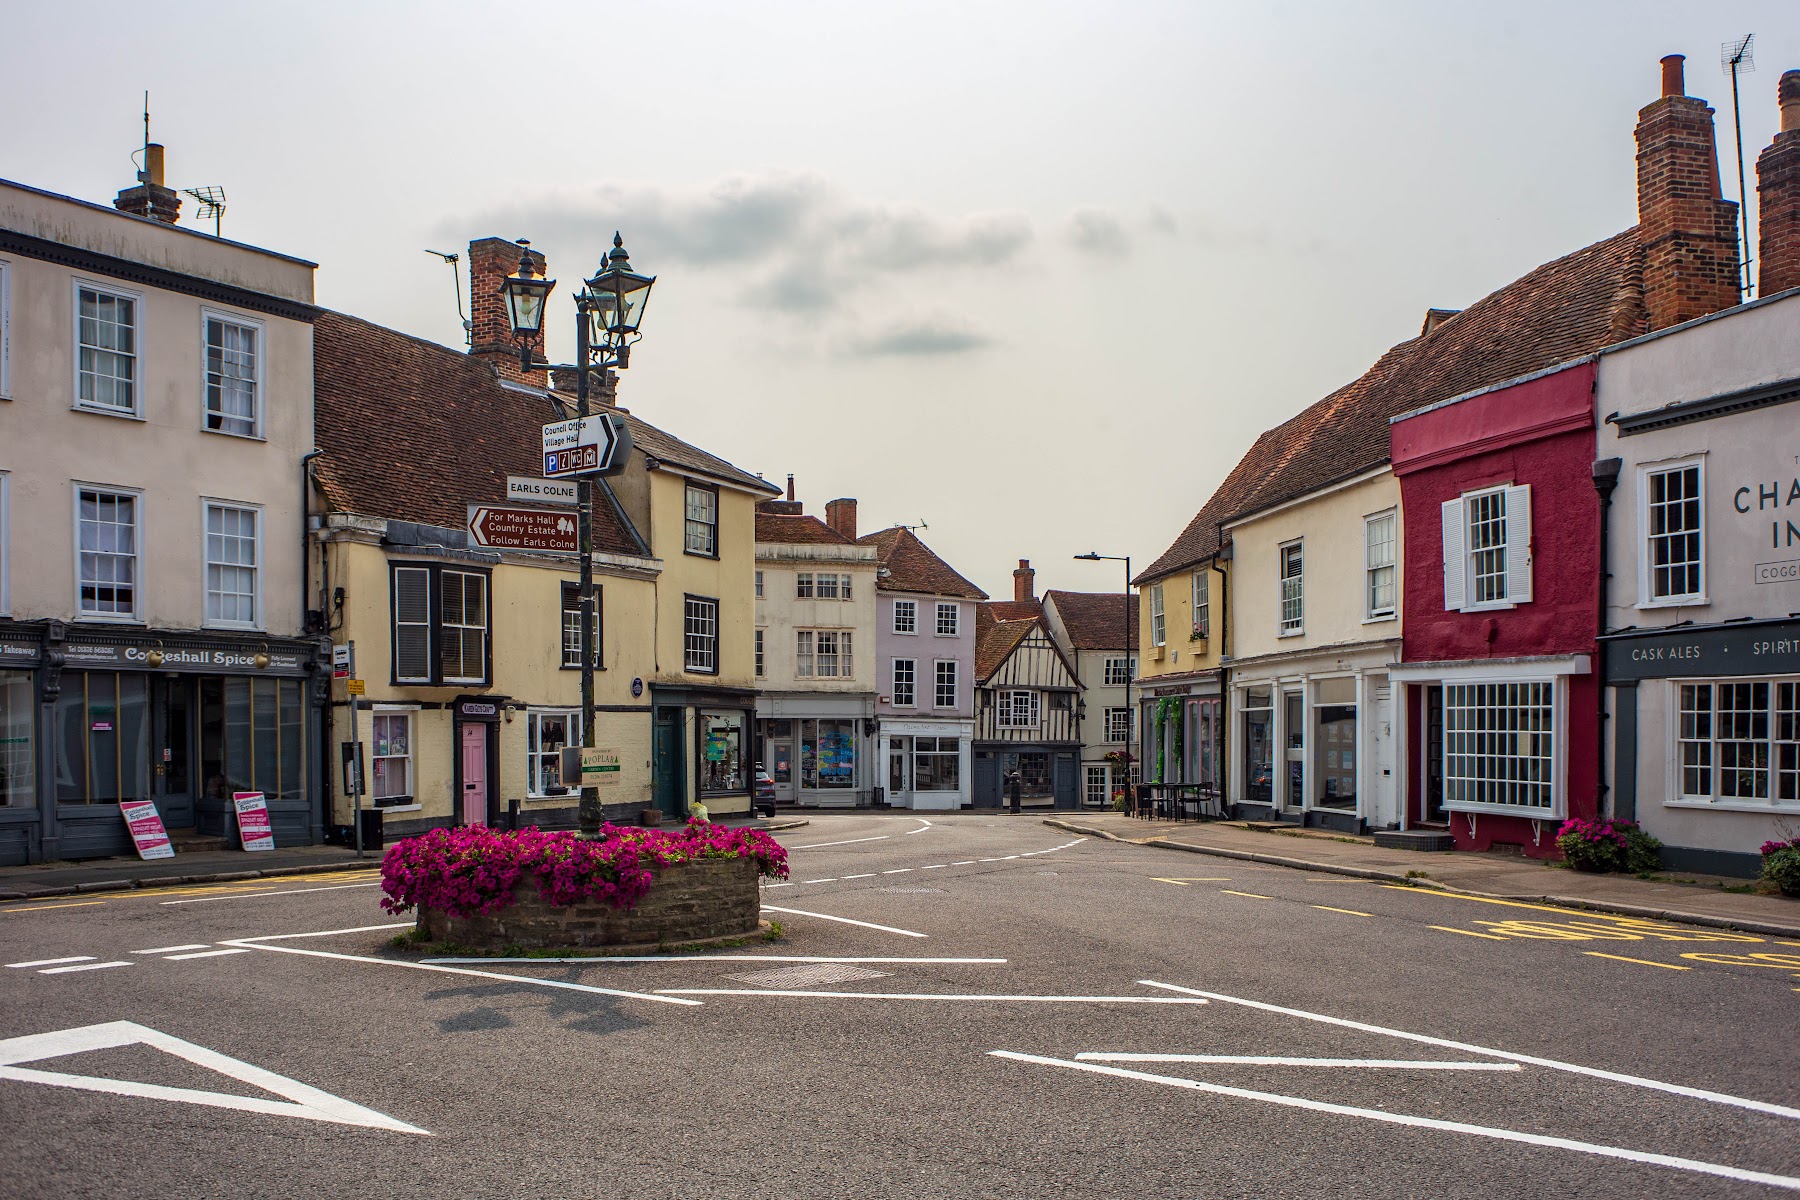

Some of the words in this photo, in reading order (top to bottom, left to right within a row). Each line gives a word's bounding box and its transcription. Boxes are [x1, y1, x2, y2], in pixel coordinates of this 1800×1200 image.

[545, 424, 567, 436] Council
[545, 438, 565, 447] Village
[566, 434, 578, 444] Hall
[511, 483, 540, 494] EARLS
[543, 486, 574, 497] COLNE
[1734, 478, 1800, 514] CHA
[489, 512, 504, 521] For
[507, 513, 534, 524] Marks
[536, 515, 555, 525] Hall
[488, 522, 525, 535] Country
[527, 525, 556, 536] Estate
[1772, 519, 1800, 549] IN
[490, 535, 520, 545] Follow
[523, 537, 546, 547] Earls
[549, 539, 575, 549] Colne
[1761, 565, 1800, 579] COGG
[4, 644, 36, 656] Takeaway
[1632, 648, 1664, 661] CASK
[1669, 645, 1700, 658] ALES
[1753, 639, 1800, 655] SPIRIT
[125, 647, 209, 664] Coeshall
[213, 651, 255, 667] Spice
[587, 754, 615, 765] POPLAR
[823, 755, 848, 764] CAFE
[821, 767, 851, 776] BIJOU
[240, 802, 260, 811] Spice
[129, 811, 150, 820] Spice
